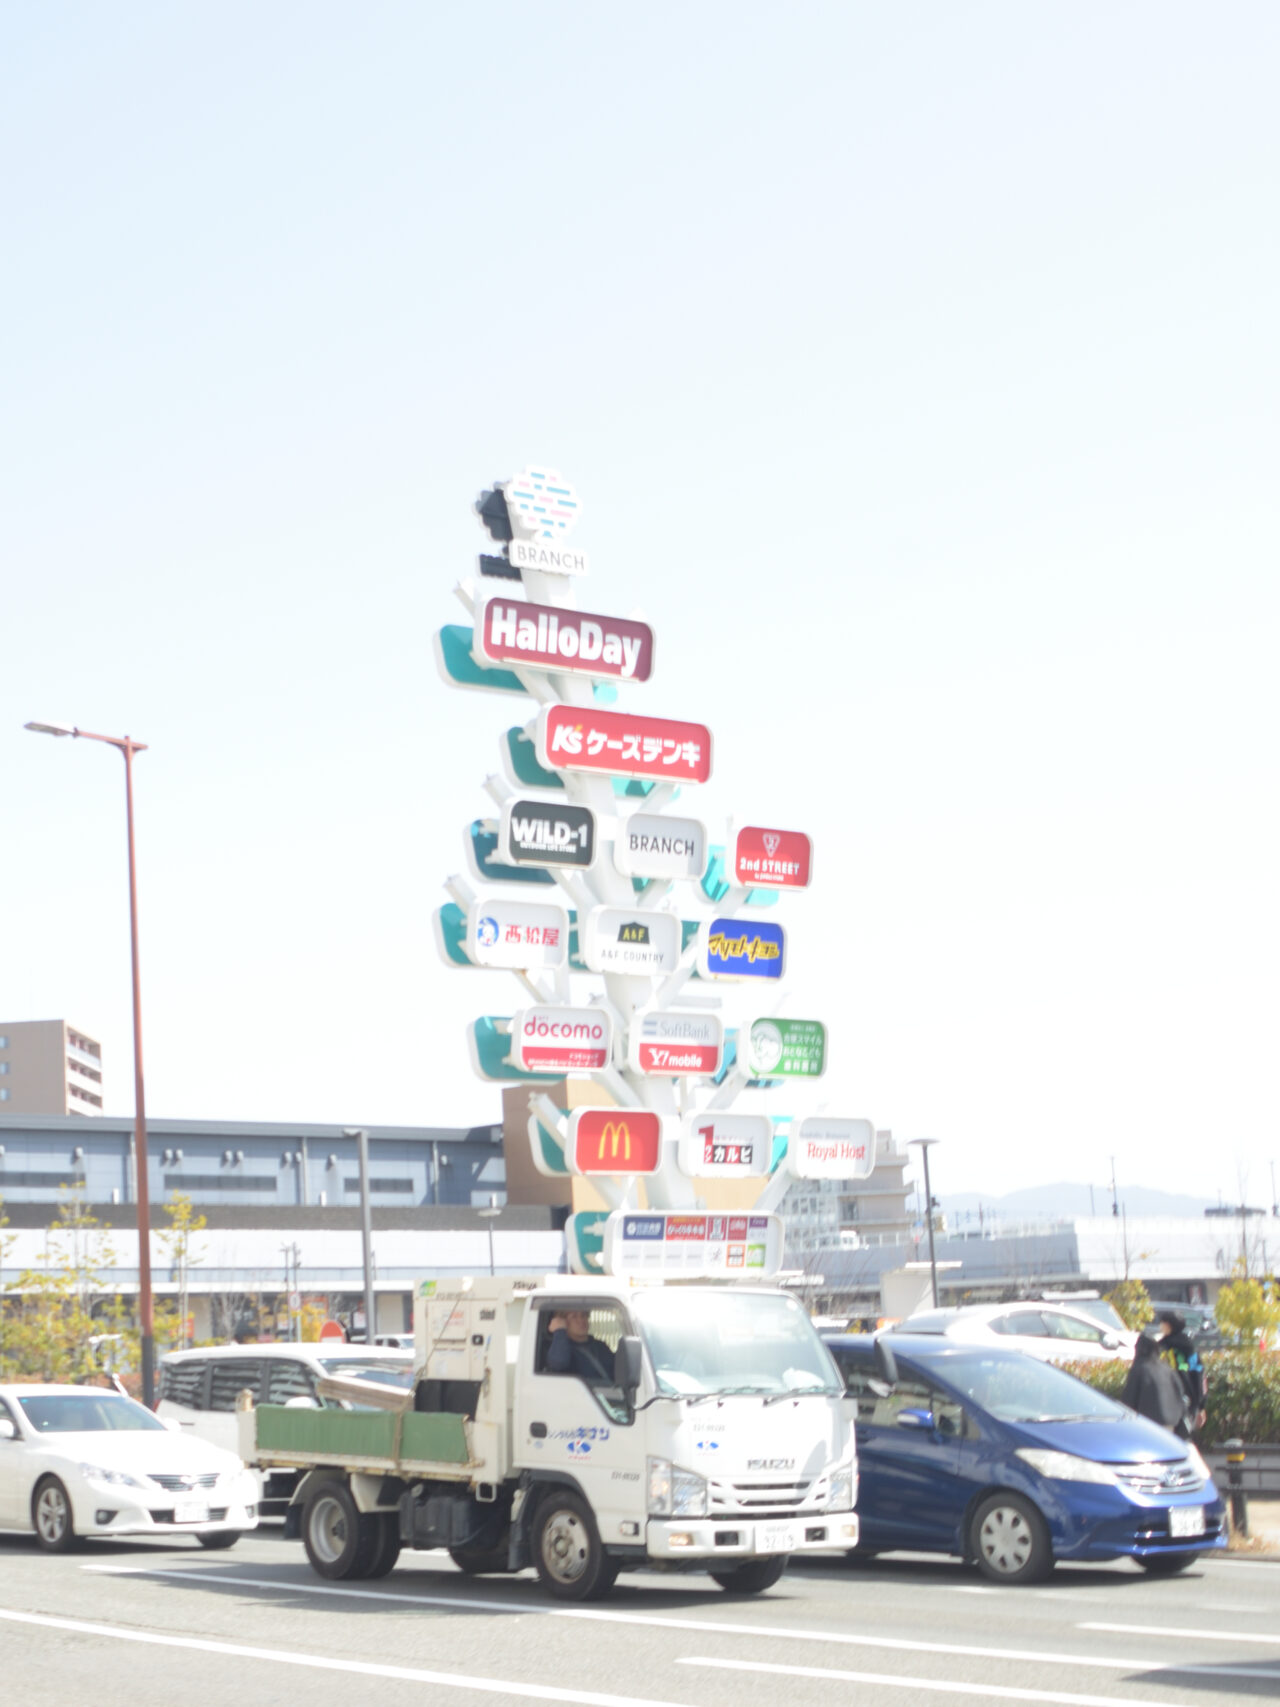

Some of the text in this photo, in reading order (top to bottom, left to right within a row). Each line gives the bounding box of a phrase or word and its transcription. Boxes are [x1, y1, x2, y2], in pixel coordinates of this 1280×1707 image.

[517, 545, 585, 571] BRANCH
[491, 606, 642, 677] HalloDay
[586, 728, 701, 767] ケーズデンキ
[511, 817, 588, 848] WILD-1
[629, 834, 695, 857] BRANCH
[740, 857, 800, 876] 2nd STREET
[505, 925, 560, 947] 西松屋
[622, 927, 645, 942] A&F
[623, 951, 664, 964] COUNTRY
[524, 1015, 603, 1040] docomo
[660, 1021, 710, 1040] SoftBank
[807, 1142, 866, 1161] Royal Host
[747, 1457, 796, 1471] ISUZU
